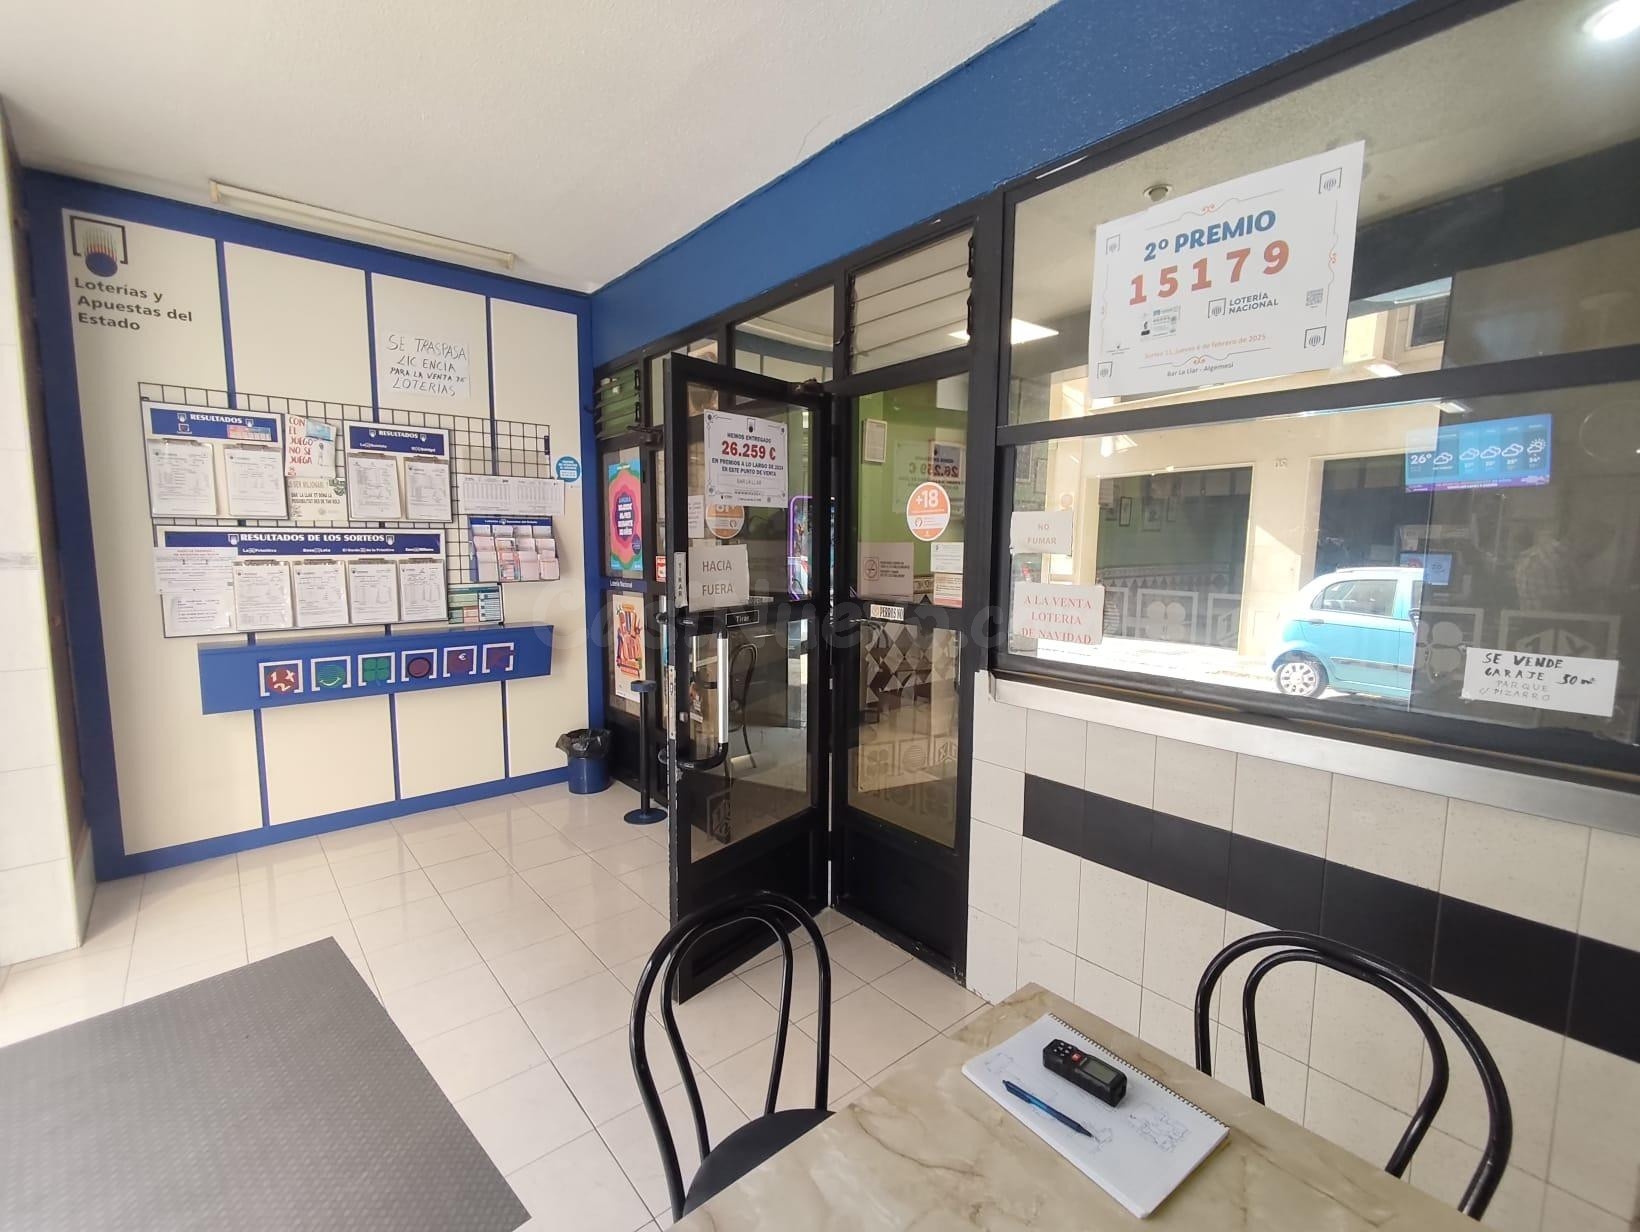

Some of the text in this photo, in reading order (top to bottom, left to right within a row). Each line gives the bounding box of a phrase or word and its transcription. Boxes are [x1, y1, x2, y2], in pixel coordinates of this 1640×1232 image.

[1174, 210, 1276, 253] PREMIO
[74, 278, 163, 303] Loterías y
[1229, 292, 1269, 307] LOTERÍA
[1229, 299, 1278, 314] NACIONAL
[78, 295, 192, 322] Apuestas del
[78, 312, 140, 331] Estado
[386, 334, 466, 360] SE TRASPASA
[390, 367, 410, 377] PARA
[427, 372, 452, 381] VENTA
[190, 414, 243, 424] RESULTADOS
[289, 416, 305, 426] CON
[291, 436, 313, 446] JUEGO
[379, 430, 418, 439] RESULTADOS
[727, 432, 771, 443] HEMOS ENTREGADO
[722, 440, 776, 460] 26.259 €
[916, 489, 939, 508] +18
[240, 534, 384, 542] RESULTADOS DE LOS SORTEOS
[702, 560, 732, 573] HACIA
[702, 584, 734, 596] FUERA
[1024, 595, 1092, 609] A LA VENTA
[880, 607, 896, 619] PERROS
[1022, 628, 1092, 644] DE NAVIDAD
[1482, 653, 1563, 668] SE VENDE
[1485, 667, 1545, 680] GARAJE
[1496, 680, 1548, 691] PARQUE
[1494, 688, 1551, 701] PIZARRO
